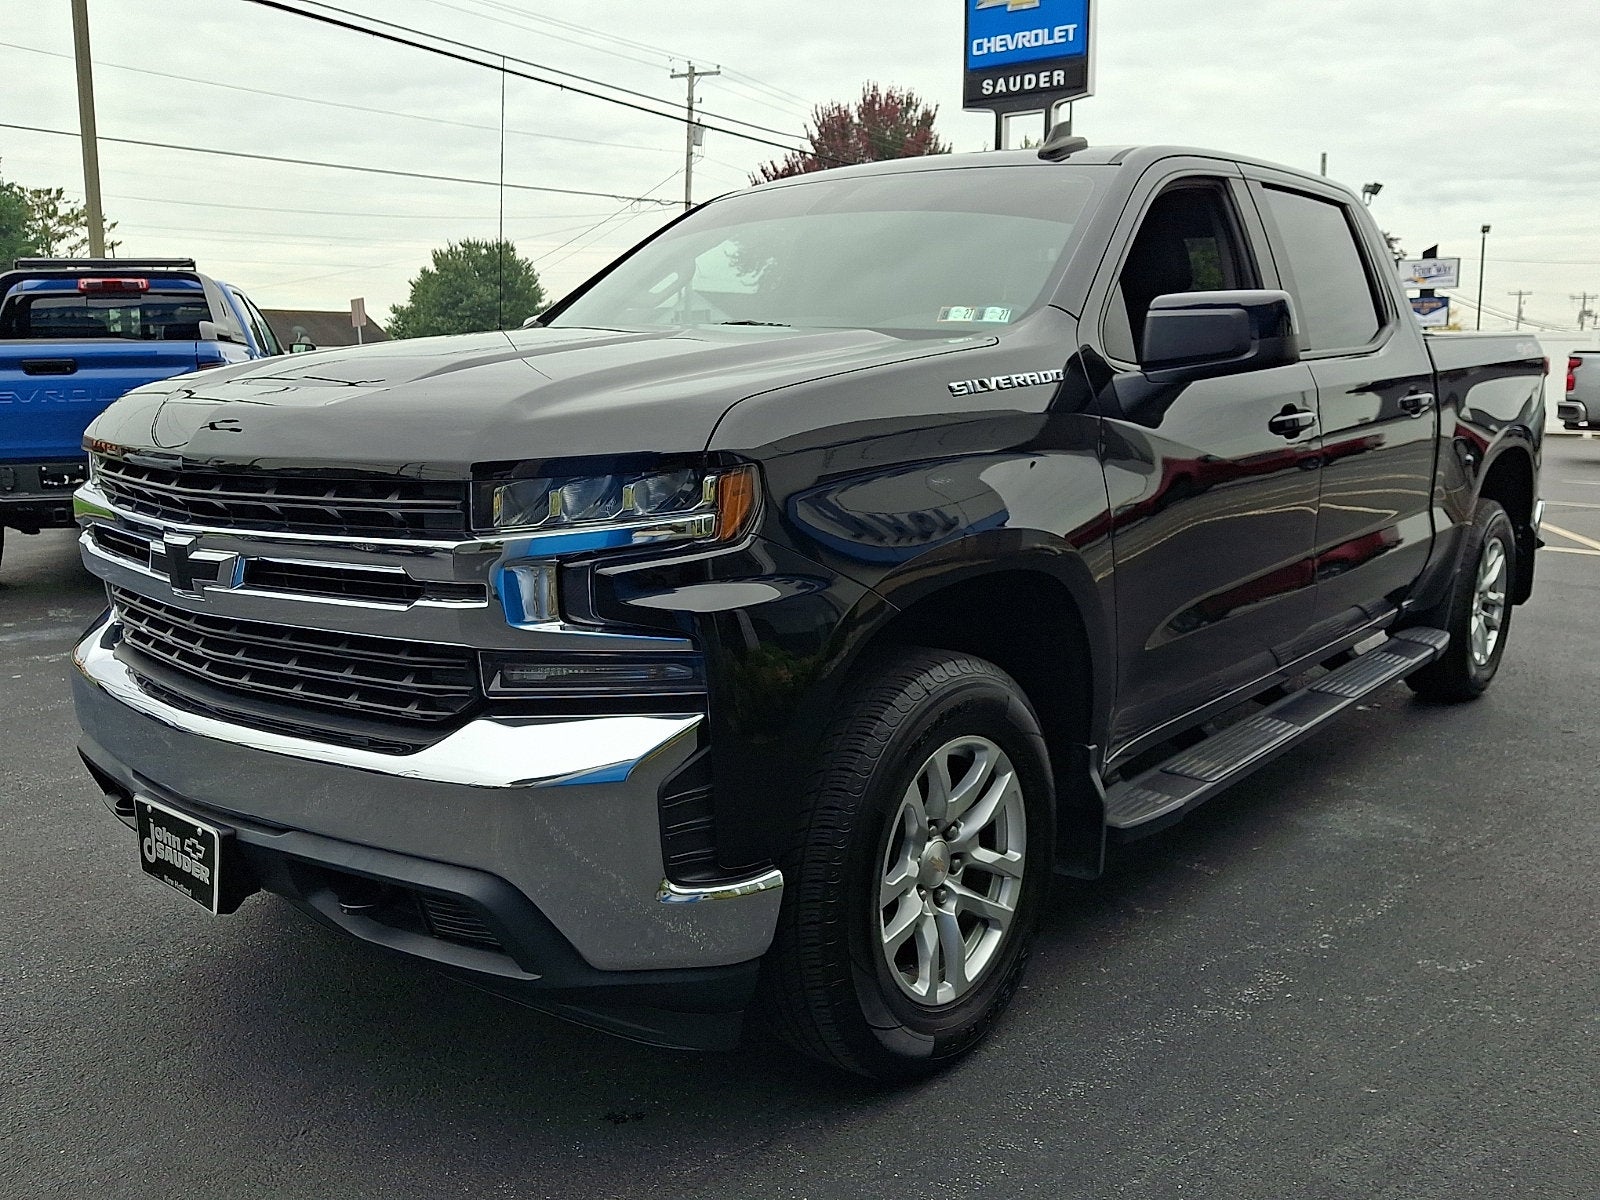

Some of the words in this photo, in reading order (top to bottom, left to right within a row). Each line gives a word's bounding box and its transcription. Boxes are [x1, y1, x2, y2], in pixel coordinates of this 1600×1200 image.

[972, 24, 1078, 56] CHEVROLET
[981, 69, 1066, 95] SAUDER
[963, 308, 974, 319] 27
[998, 309, 1009, 320] 27
[948, 369, 1065, 397] SILVERADO
[156, 841, 210, 885] SAUDER
